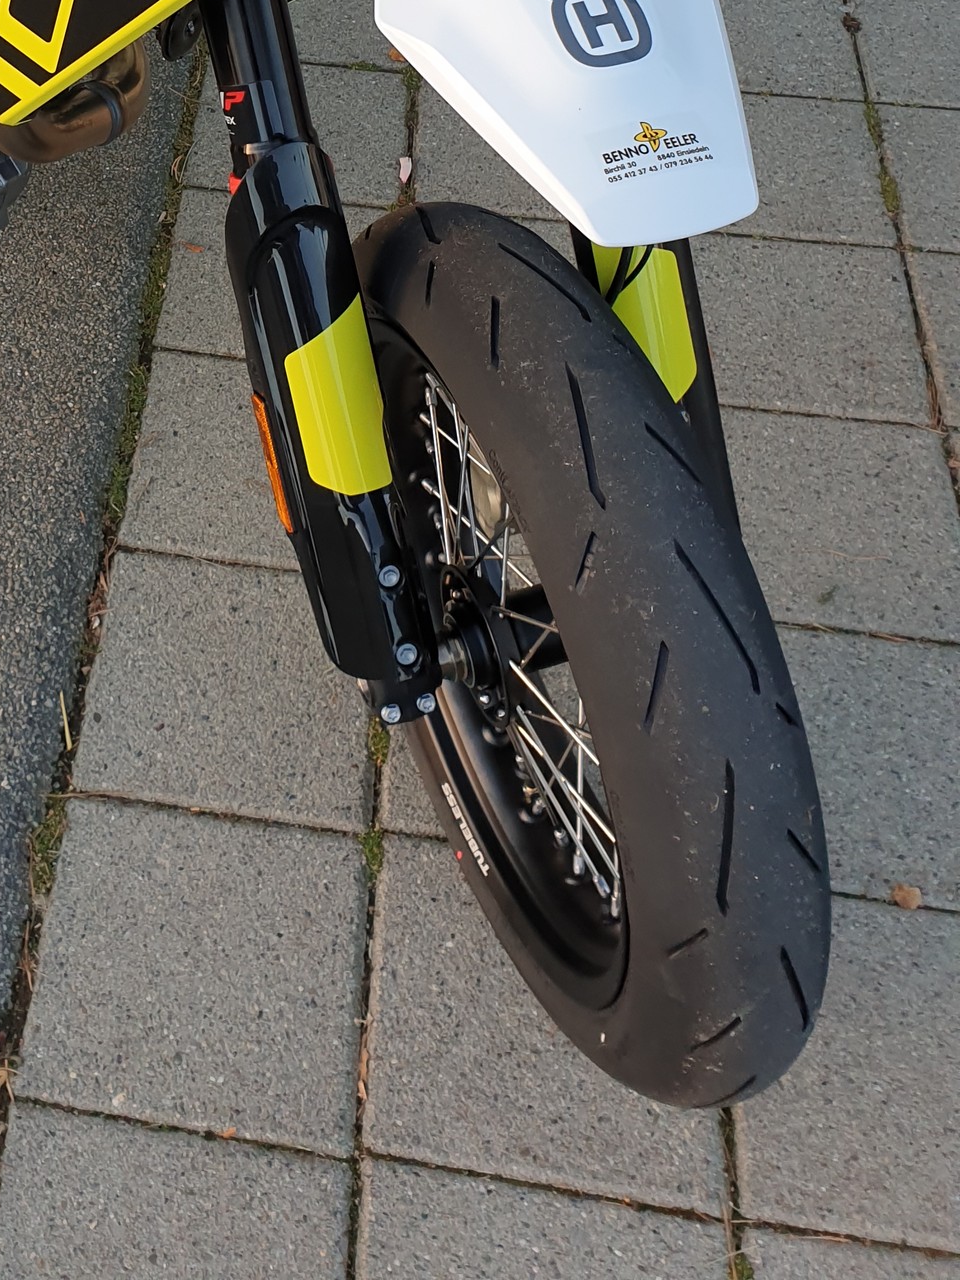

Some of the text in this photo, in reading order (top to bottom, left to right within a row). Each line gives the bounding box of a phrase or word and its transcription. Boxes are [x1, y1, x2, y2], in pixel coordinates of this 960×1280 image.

[602, 144, 650, 164] BENNO
[627, 161, 637, 169] 30
[657, 152, 676, 161] 8840
[676, 146, 710, 157] Einsiedeln
[608, 174, 623, 183] 055
[624, 171, 637, 179] 412
[648, 165, 658, 173] 43
[664, 160, 678, 169] 079
[679, 157, 693, 166] 236
[694, 155, 704, 163] 56
[704, 153, 714, 161] 46
[441, 782, 490, 877] TUBELESS
